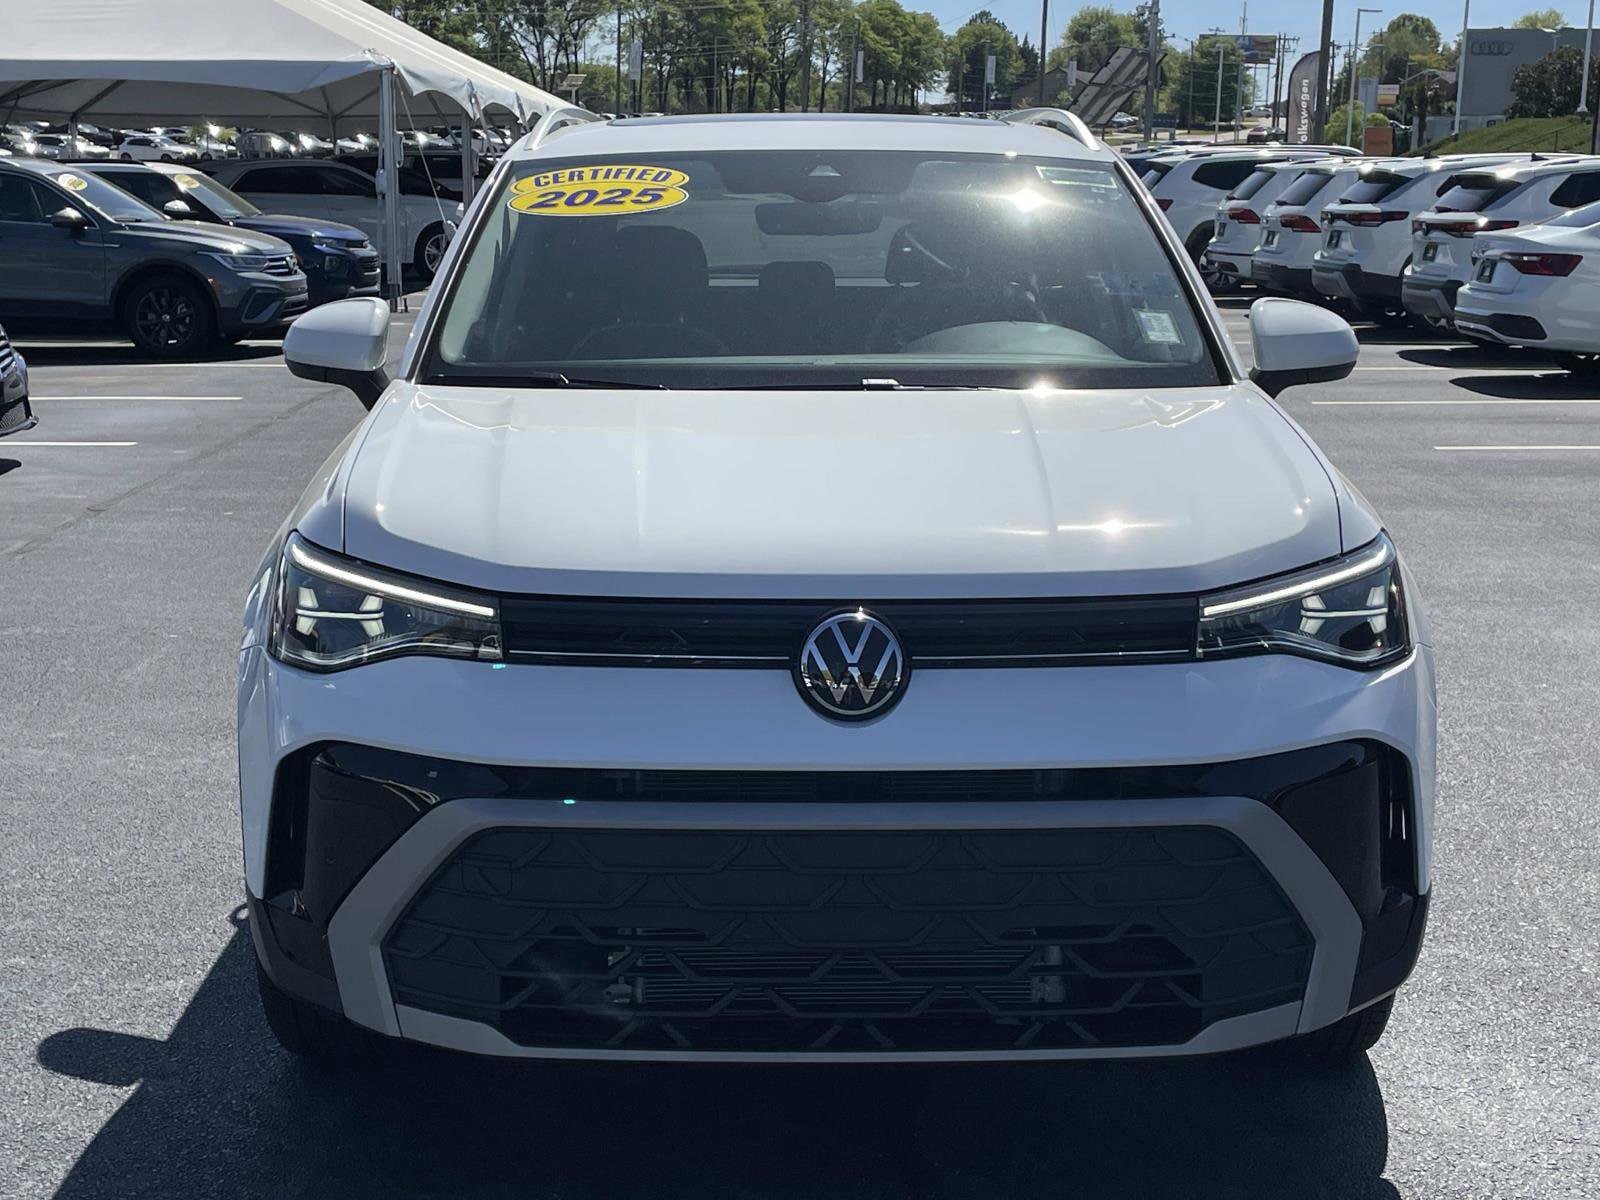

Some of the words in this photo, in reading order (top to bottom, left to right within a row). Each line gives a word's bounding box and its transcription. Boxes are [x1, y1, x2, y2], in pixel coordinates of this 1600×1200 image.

[1297, 79, 1311, 144] olkswagen
[534, 167, 673, 187] CERTIFIED
[526, 187, 669, 210] 2025
